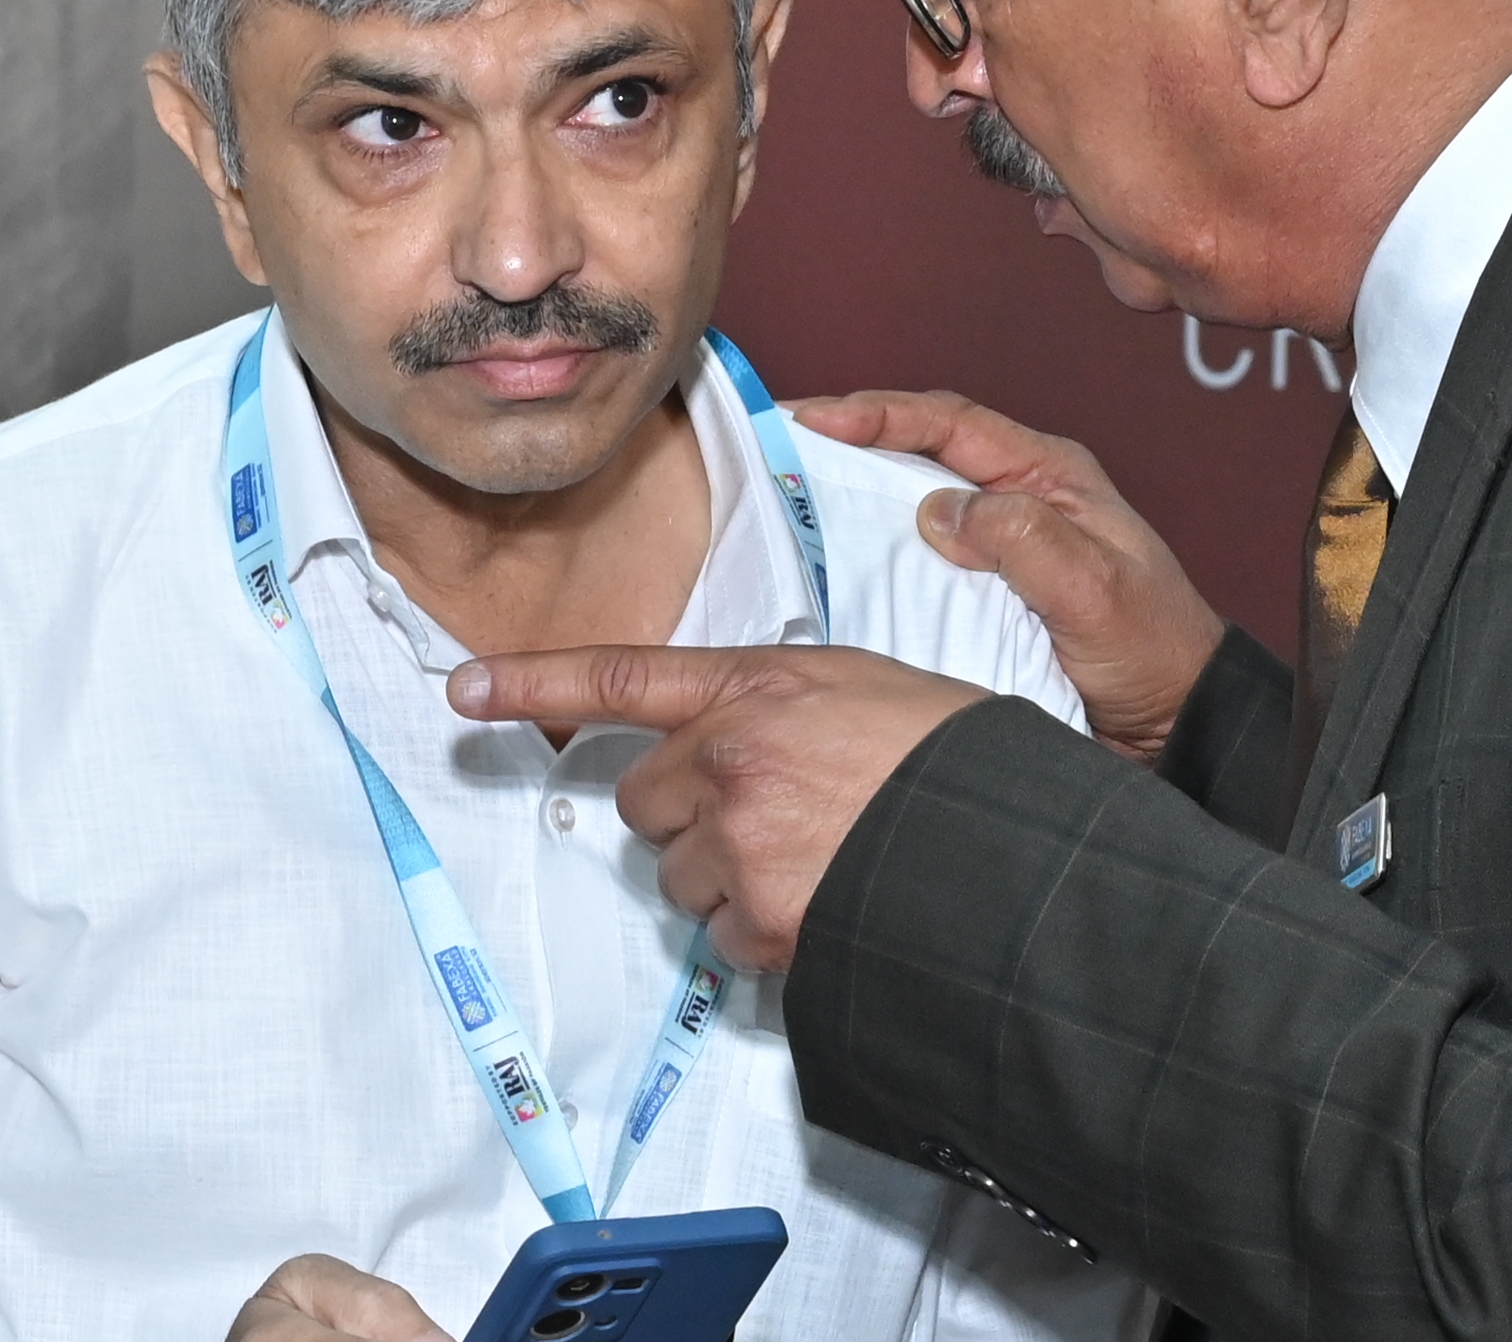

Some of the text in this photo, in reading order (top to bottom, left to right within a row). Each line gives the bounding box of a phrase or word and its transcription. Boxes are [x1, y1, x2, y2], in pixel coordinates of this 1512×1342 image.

[250, 563, 274, 607] RAJ
[440, 952, 471, 1004] FABEXA
[680, 994, 711, 1036] RAJ
[492, 1055, 527, 1099] RAJ
